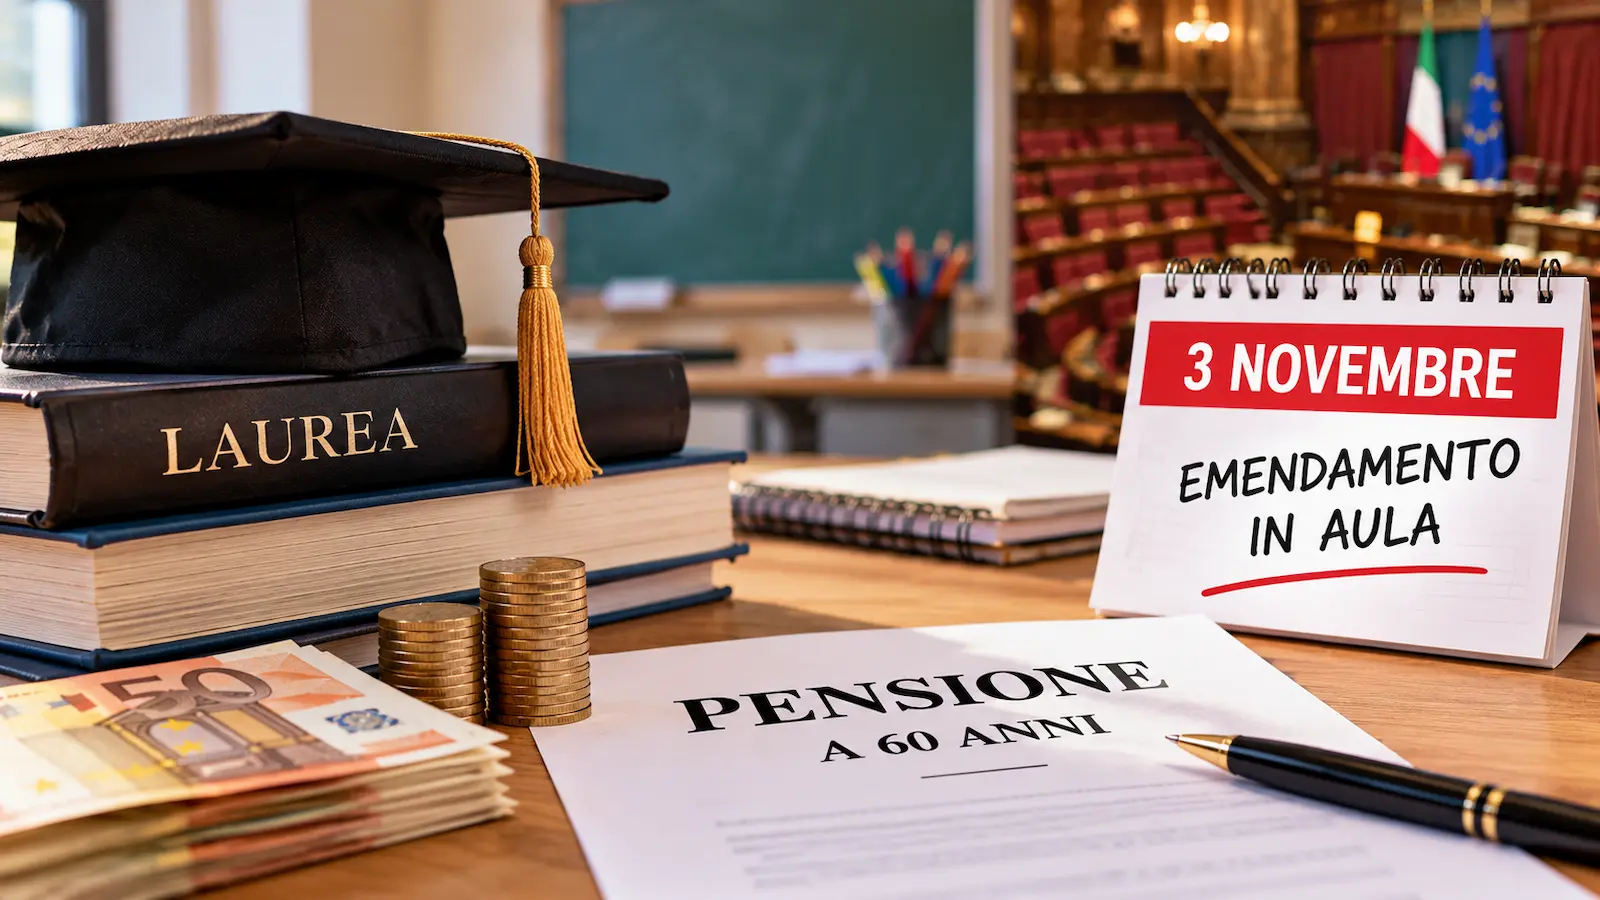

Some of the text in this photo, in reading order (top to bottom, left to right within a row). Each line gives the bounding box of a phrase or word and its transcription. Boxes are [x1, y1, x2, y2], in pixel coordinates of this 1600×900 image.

[1184, 342, 1517, 399] 3 NOVEMBRE
[161, 408, 419, 476] LAUREA
[1179, 438, 1521, 503] EMENDAMENTO
[1250, 503, 1441, 557] IN AULA
[101, 667, 273, 718] 50
[673, 660, 1169, 734] PENSIONE
[820, 714, 1112, 763] A 60 ANNI
